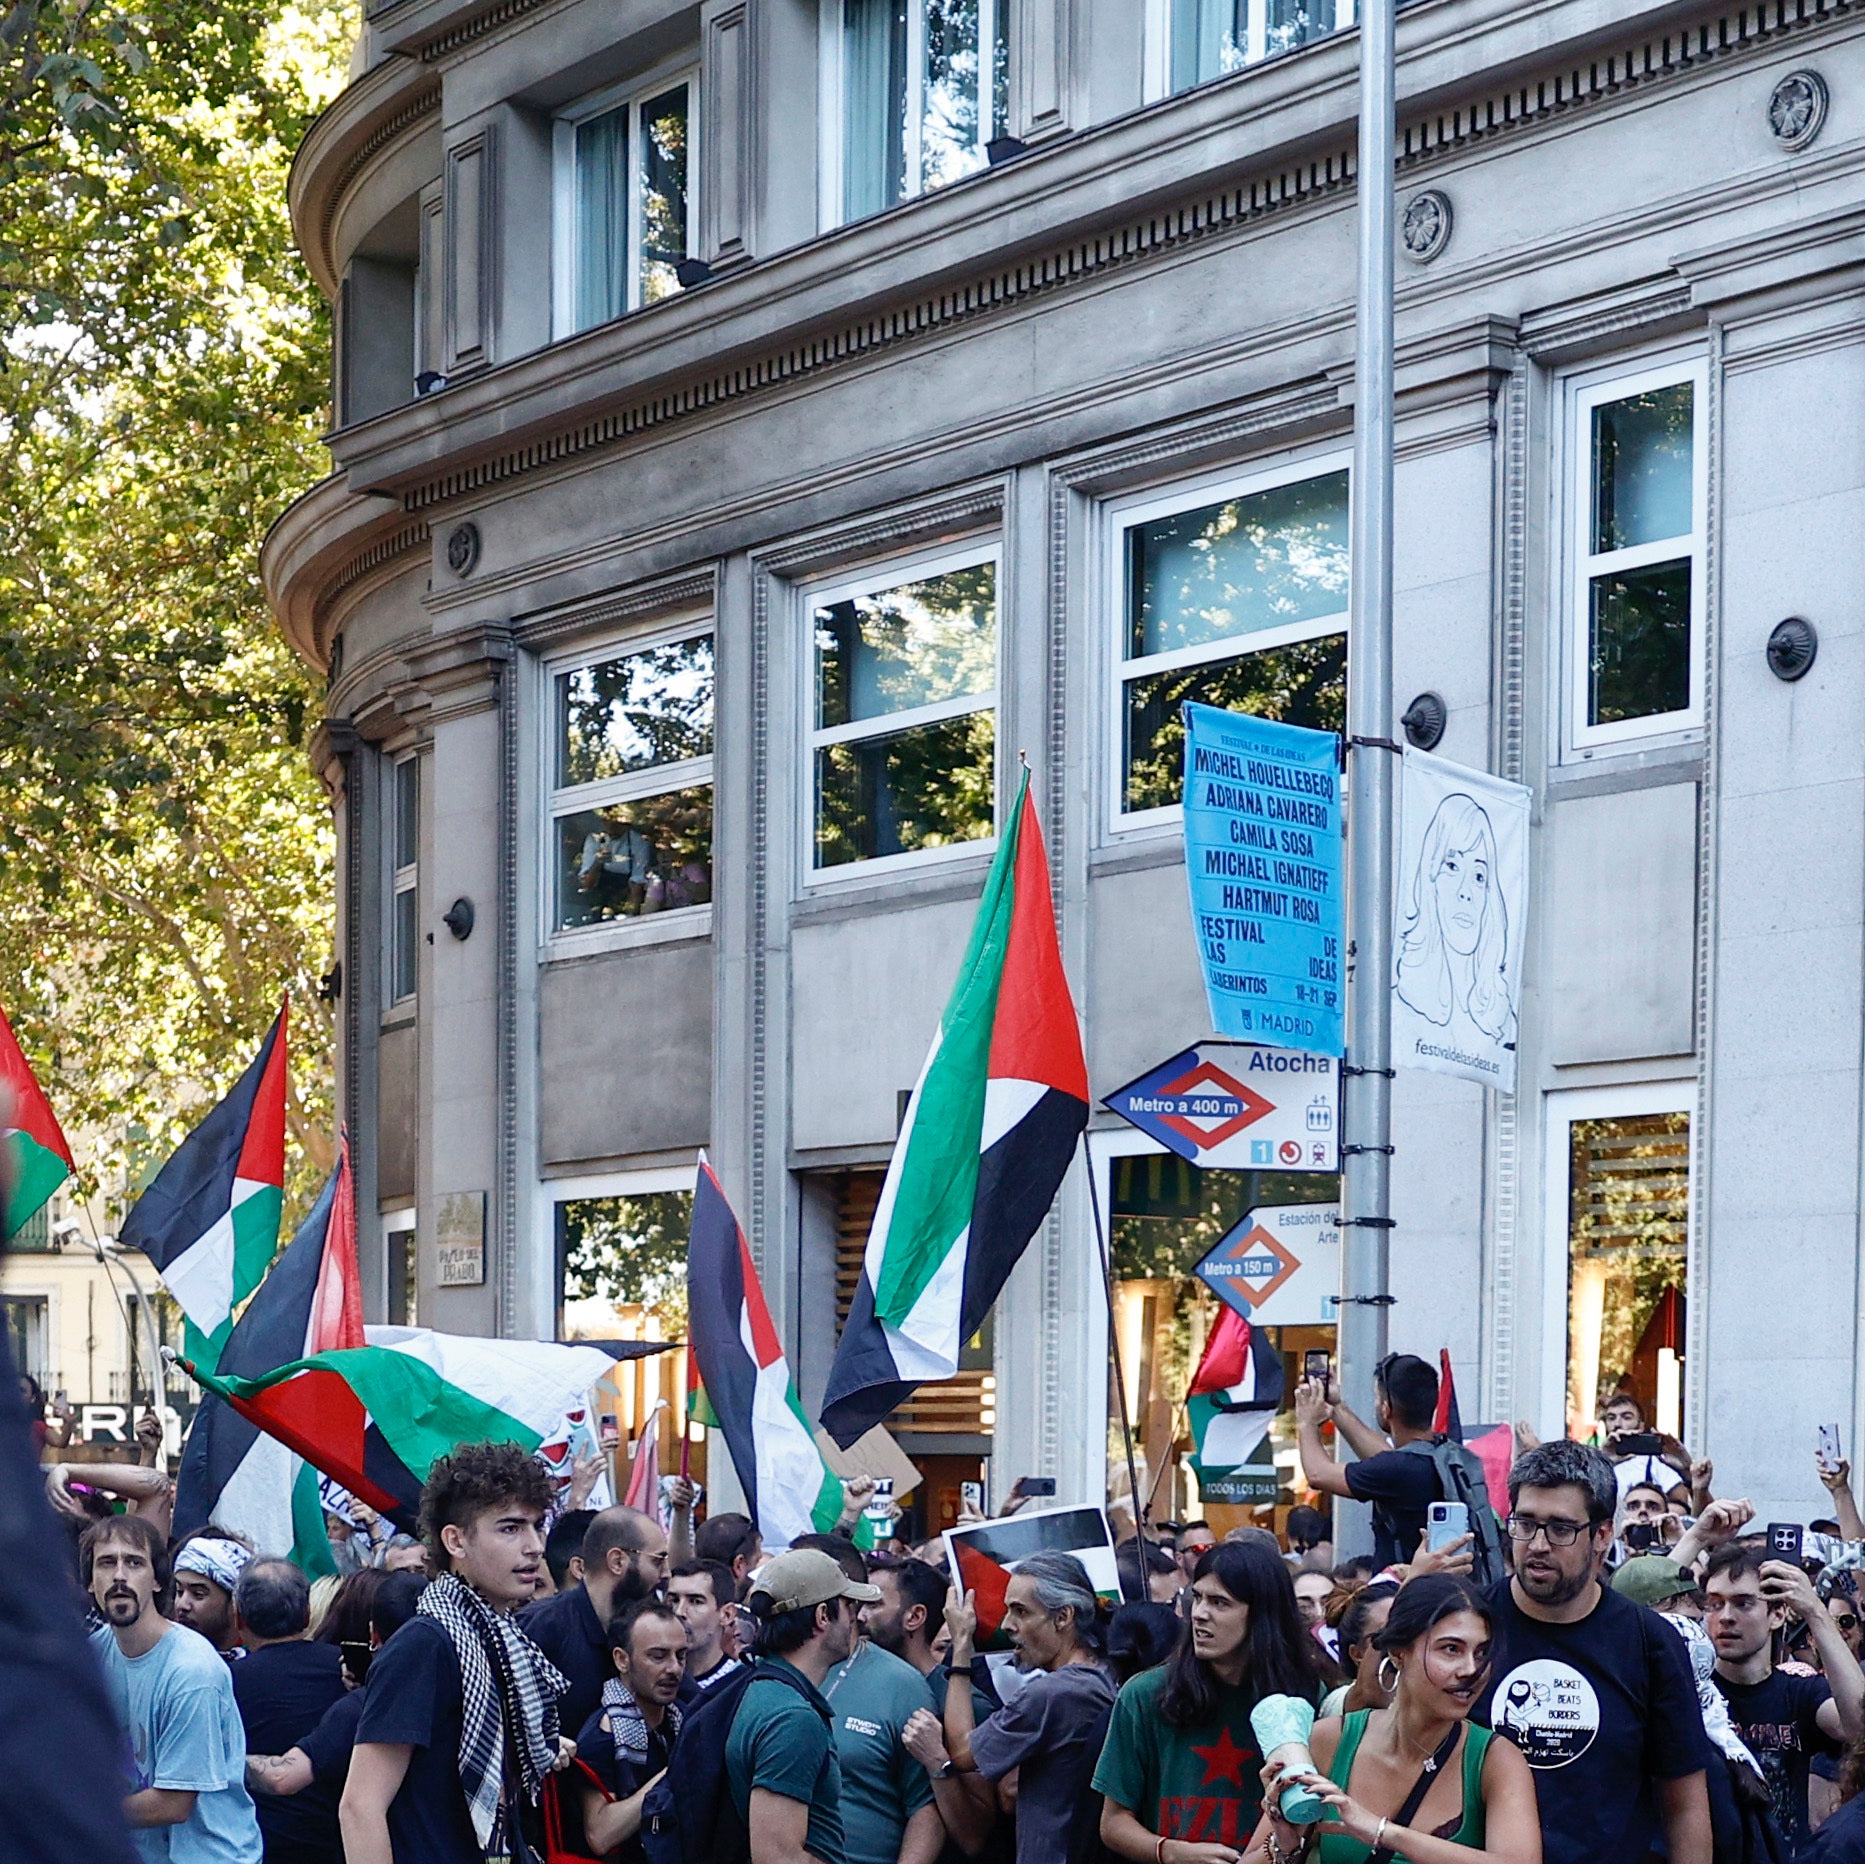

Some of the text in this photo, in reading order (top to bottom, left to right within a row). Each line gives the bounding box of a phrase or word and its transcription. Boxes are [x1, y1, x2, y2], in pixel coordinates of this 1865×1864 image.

[1195, 747, 1334, 804] MICHEL HOUELLEBECQ
[1205, 782, 1328, 830] ADRIANA CAVARERO
[1230, 819, 1314, 858] CAMILA SOSA
[1205, 850, 1329, 895] MICHAEL IGNATIEFF
[1222, 884, 1321, 925] HARTMUT ROSA
[1200, 915, 1338, 959] FESTIVAL DE
[1204, 939, 1338, 983] LAS IDEAS
[1209, 967, 1268, 995] LABERINTOS
[1323, 989, 1338, 1008] SEP
[1261, 1012, 1315, 1037] MADRID
[1248, 1050, 1331, 1073] Atocha
[1415, 1038, 1500, 1075] festivaldelasideas.es
[1129, 1097, 1238, 1114] Metro a 400 m
[1257, 1142, 1268, 1162] 1
[1279, 1211, 1321, 1227] Estación
[1318, 1231, 1339, 1244] Arte
[1204, 1261, 1273, 1276] Metro a 150 m
[1205, 1482, 1235, 1495] TODOS
[1236, 1483, 1254, 1495] LOS
[1553, 1678, 1581, 1690] BASKET
[1557, 1694, 1582, 1705] BEATS
[1548, 1709, 1581, 1720] BORDERS
[1158, 1795, 1264, 1848] EZL
